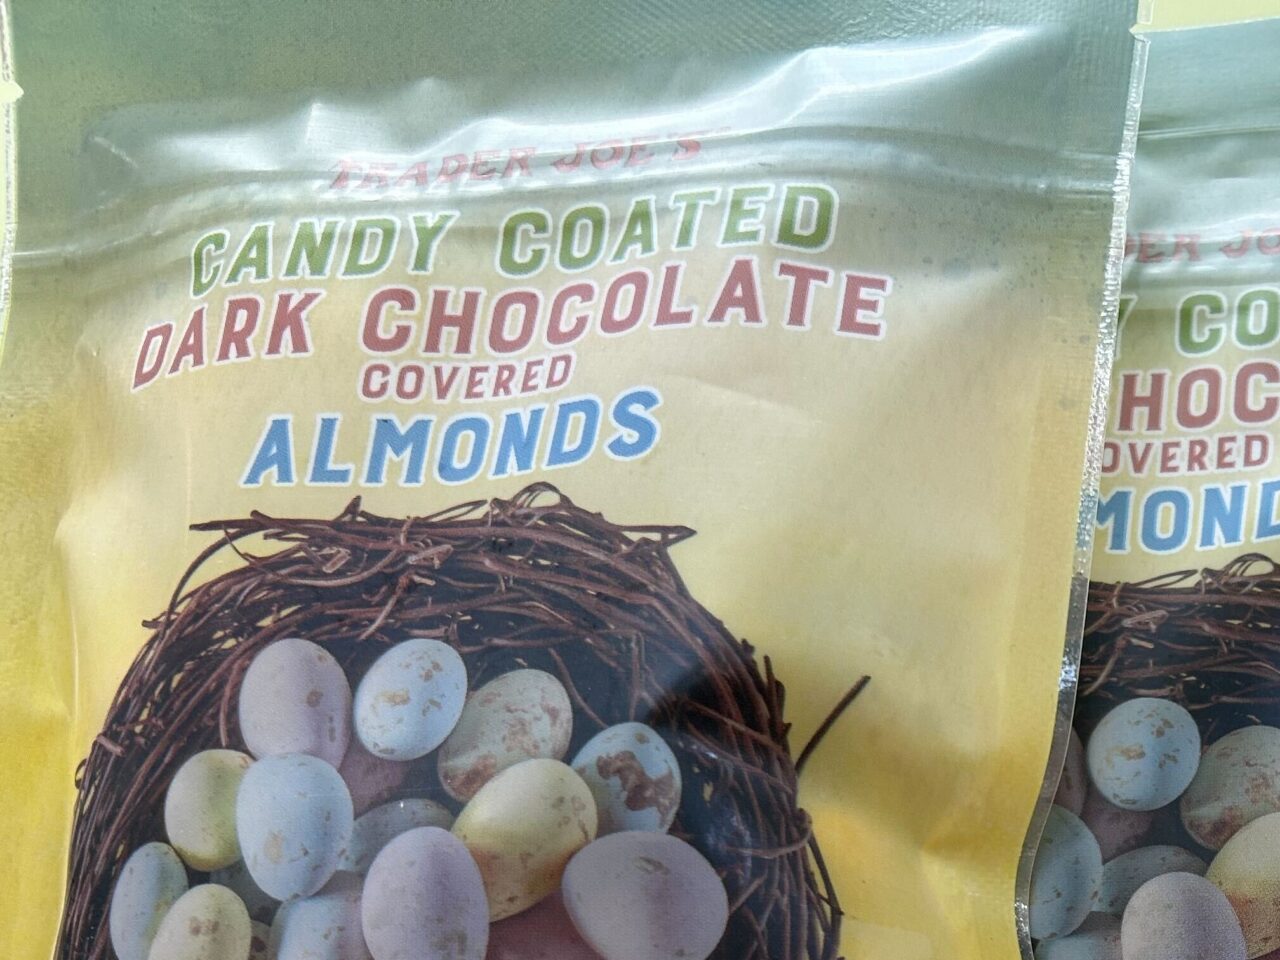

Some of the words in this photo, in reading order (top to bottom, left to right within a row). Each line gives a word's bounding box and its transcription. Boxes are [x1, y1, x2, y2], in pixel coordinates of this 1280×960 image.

[192, 213, 455, 298] CANDY
[500, 186, 838, 274] COATED
[132, 291, 323, 390] DARK
[362, 259, 889, 355] CHOCOLATE
[361, 352, 572, 400] COVERED
[243, 388, 661, 487] ALMONDS
[1100, 434, 1272, 474] OVERED
